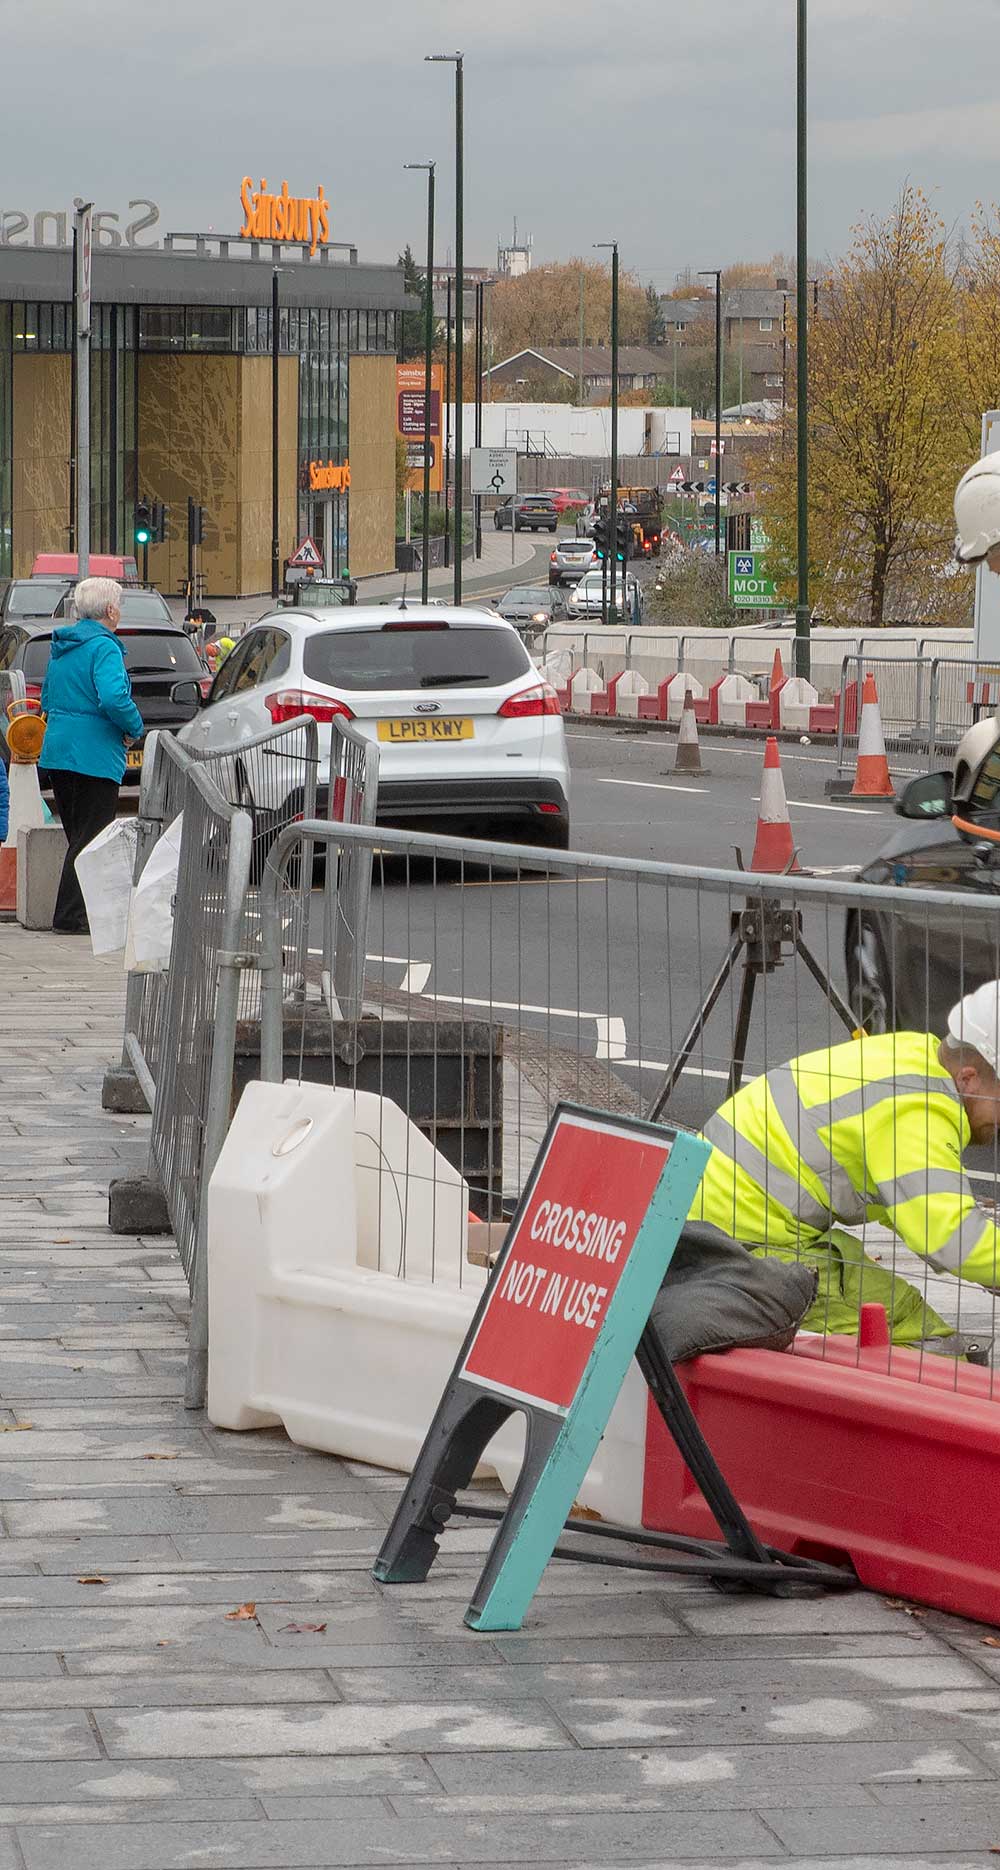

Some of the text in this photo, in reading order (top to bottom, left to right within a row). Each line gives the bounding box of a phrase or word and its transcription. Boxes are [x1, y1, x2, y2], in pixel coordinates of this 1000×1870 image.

[240, 176, 329, 256] Sainsbury's
[310, 459, 351, 494] Sainsbury's
[734, 579, 767, 593] MOT
[390, 719, 463, 737] LP13 KWY
[531, 1200, 627, 1263] CROSSING
[500, 1260, 608, 1328] NOT IN USE
